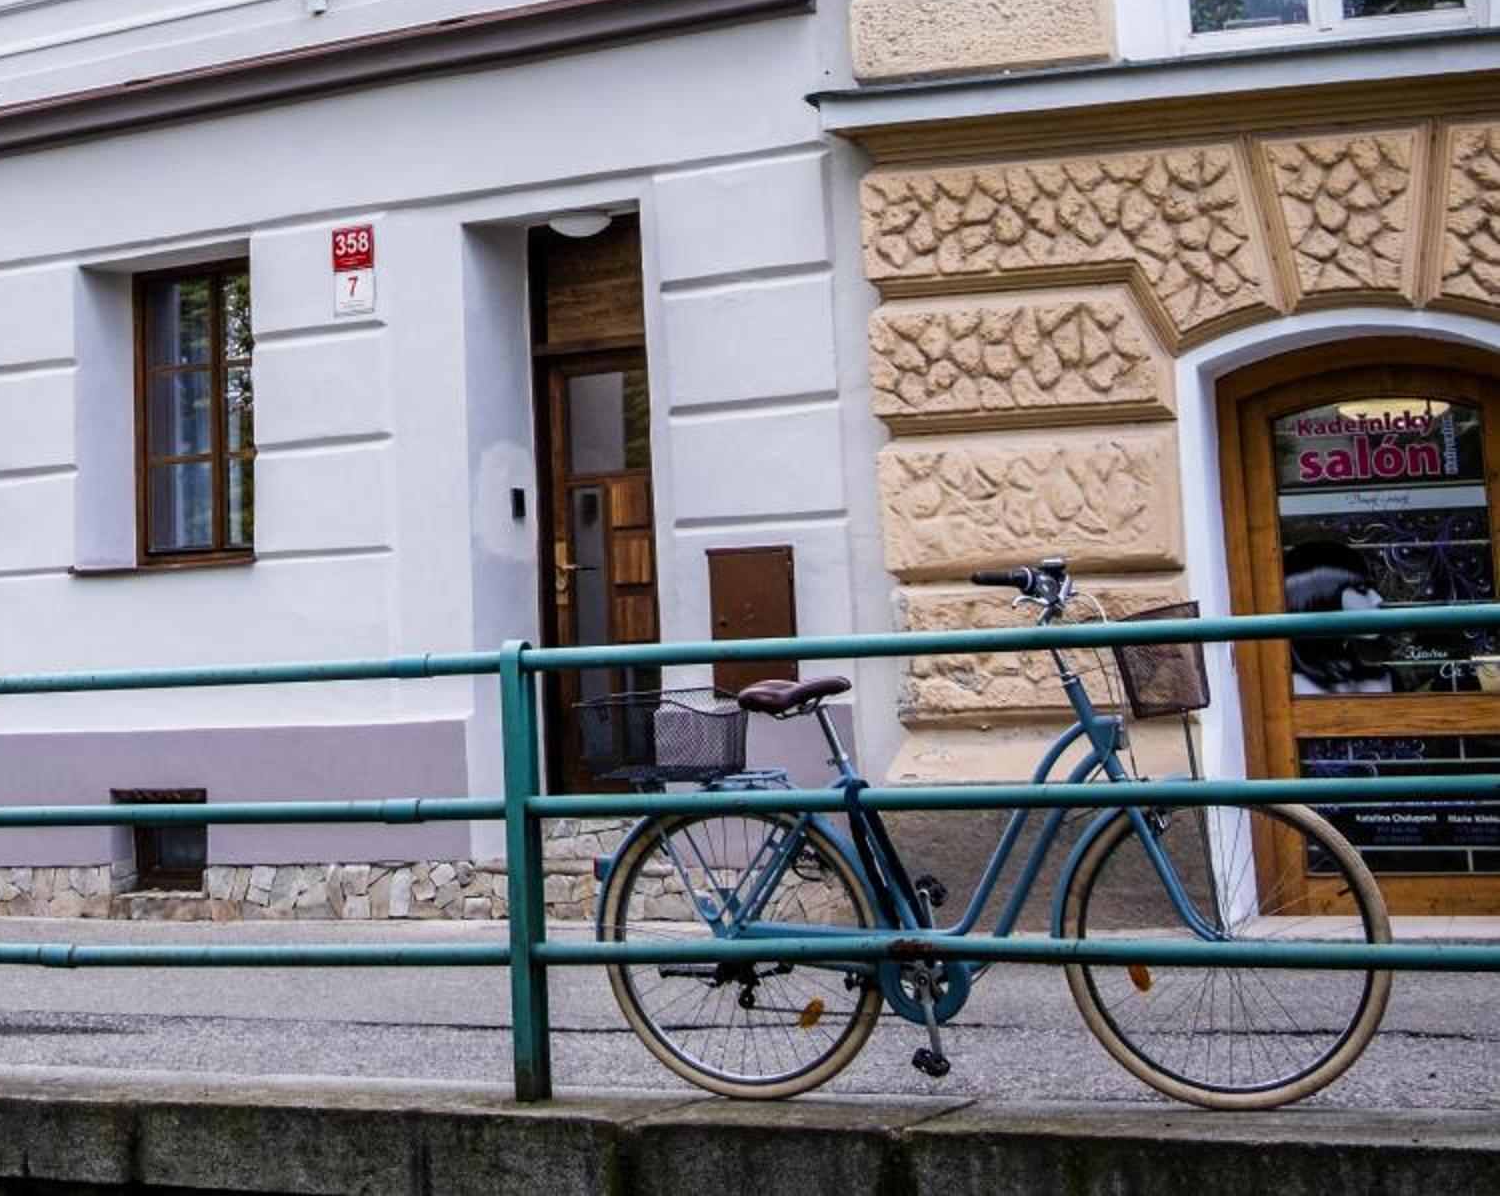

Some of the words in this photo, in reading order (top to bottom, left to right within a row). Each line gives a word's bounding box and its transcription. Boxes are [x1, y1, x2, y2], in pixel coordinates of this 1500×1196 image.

[335, 232, 369, 255] 358
[347, 275, 359, 297] 7
[1295, 408, 1433, 437] Kadeřnický
[1298, 434, 1441, 483] salón
